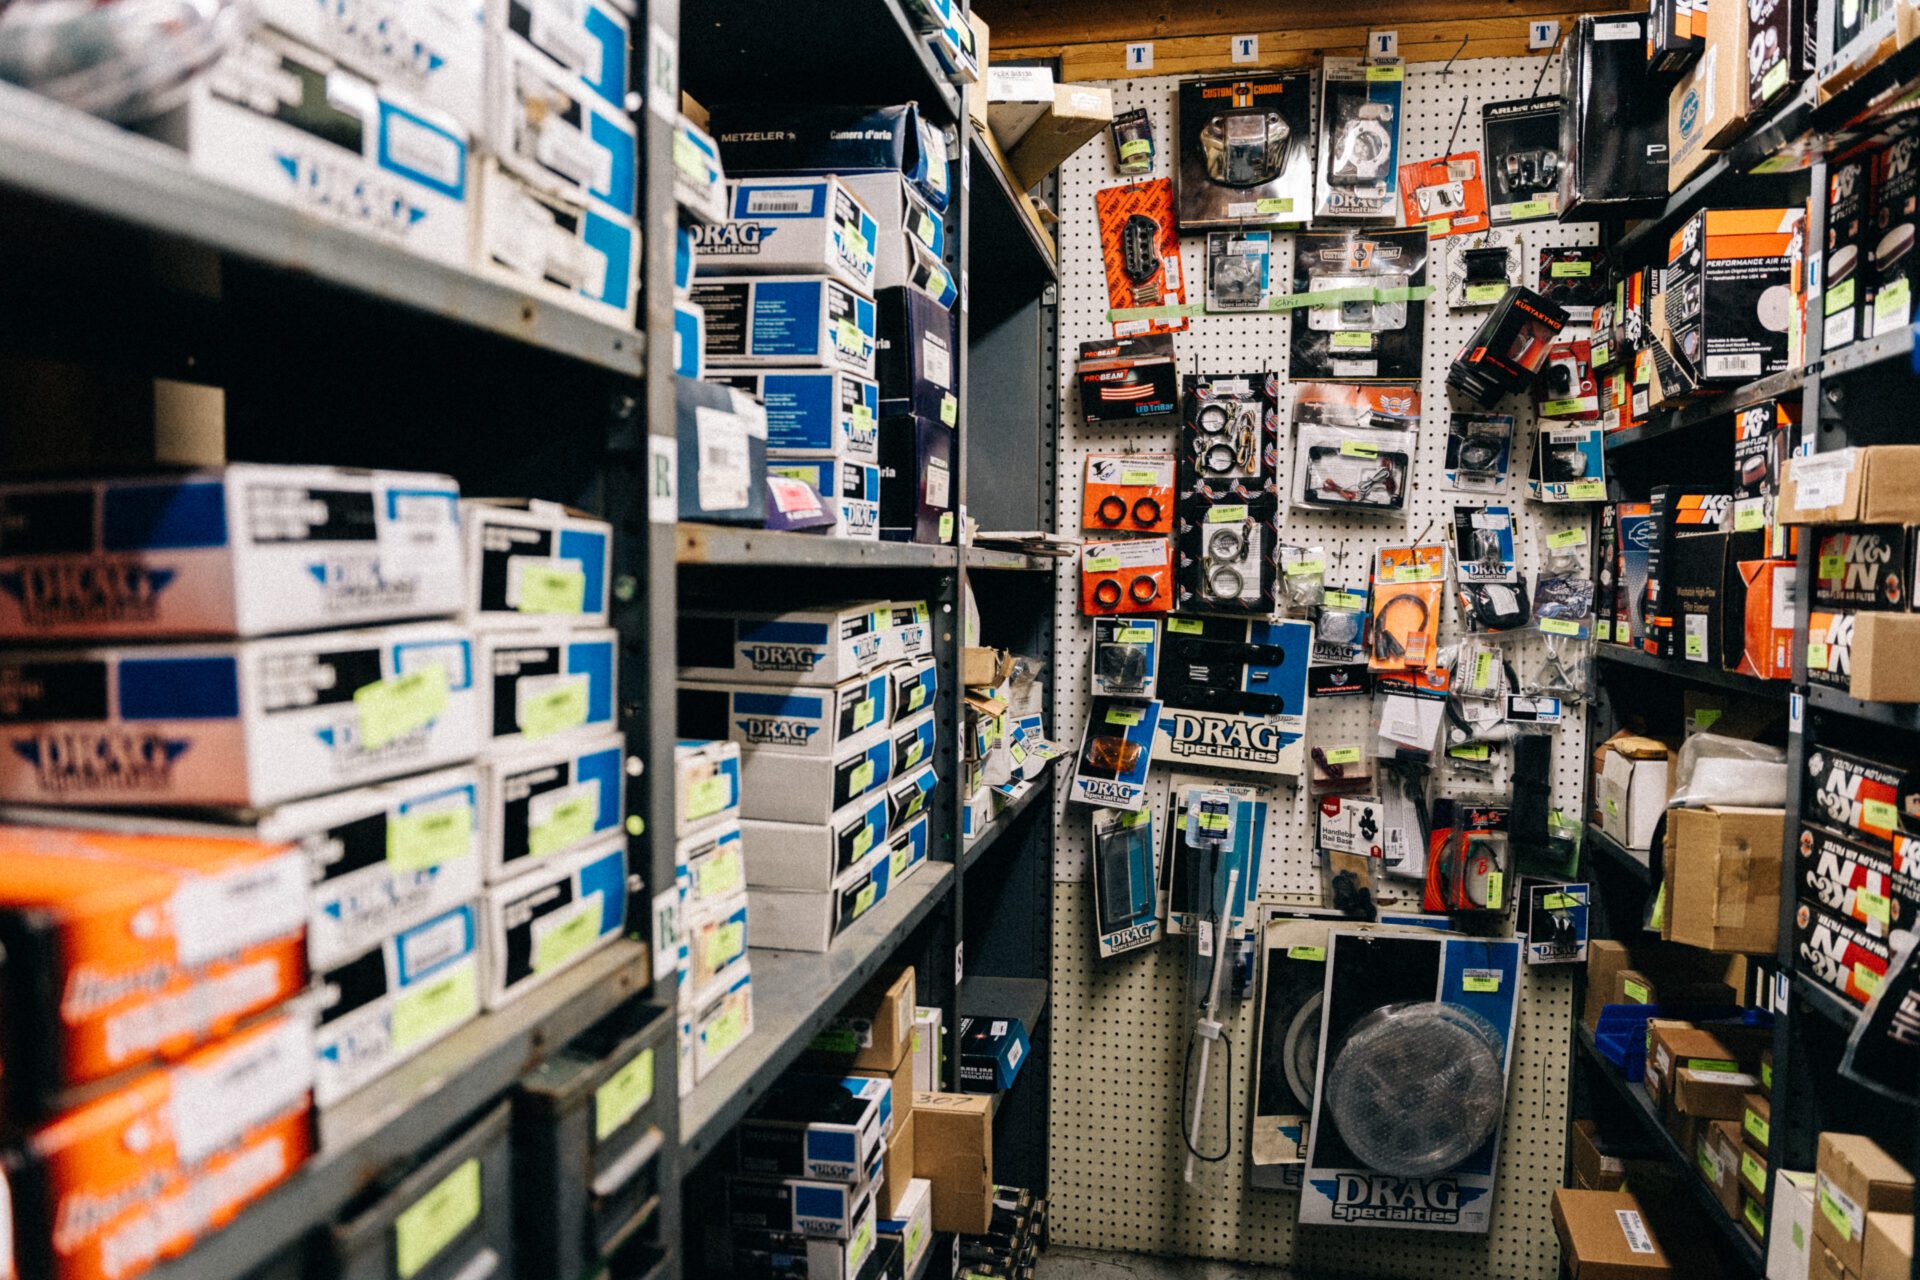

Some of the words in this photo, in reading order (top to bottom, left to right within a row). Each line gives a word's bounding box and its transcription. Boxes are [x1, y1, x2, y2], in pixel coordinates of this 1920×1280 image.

[1535, 25, 1550, 41] T
[1239, 39, 1253, 56] T
[1377, 35, 1392, 52] T
[1132, 47, 1145, 63] T
[1202, 88, 1233, 99] CUSTOM
[1253, 83, 1284, 95] CHROME
[721, 131, 784, 143] METZELER
[830, 130, 862, 140] Camera
[1706, 258, 1763, 268] PERFORMANCE
[1764, 256, 1779, 265] AIR
[1084, 348, 1118, 358] PROBEAM
[1083, 371, 1125, 383] PROBEAM
[1135, 405, 1149, 414] LED
[655, 453, 672, 498] R
[1468, 562, 1507, 576] DRAG
[1844, 534, 1892, 592] K&N
[753, 645, 814, 665] DRAG
[1790, 695, 1802, 721] U
[748, 718, 808, 739] DRAG
[1174, 713, 1281, 754] DRAG
[1172, 739, 1280, 764] Specialties
[1084, 791, 1131, 804] Specialties
[1086, 779, 1132, 799] DRAG
[1816, 766, 1863, 829] K&N
[1322, 826, 1356, 839] Handlebar
[1322, 833, 1336, 841] Rail
[1336, 836, 1353, 846] Base
[1806, 851, 1857, 916] K&N
[659, 907, 677, 951] R
[1109, 923, 1151, 948] DRAG
[1111, 935, 1152, 953] Specialties
[1800, 923, 1851, 992] K&N
[1777, 970, 1788, 1001] U
[1335, 1174, 1462, 1211] DRAG
[1332, 1203, 1460, 1225] Specialties
